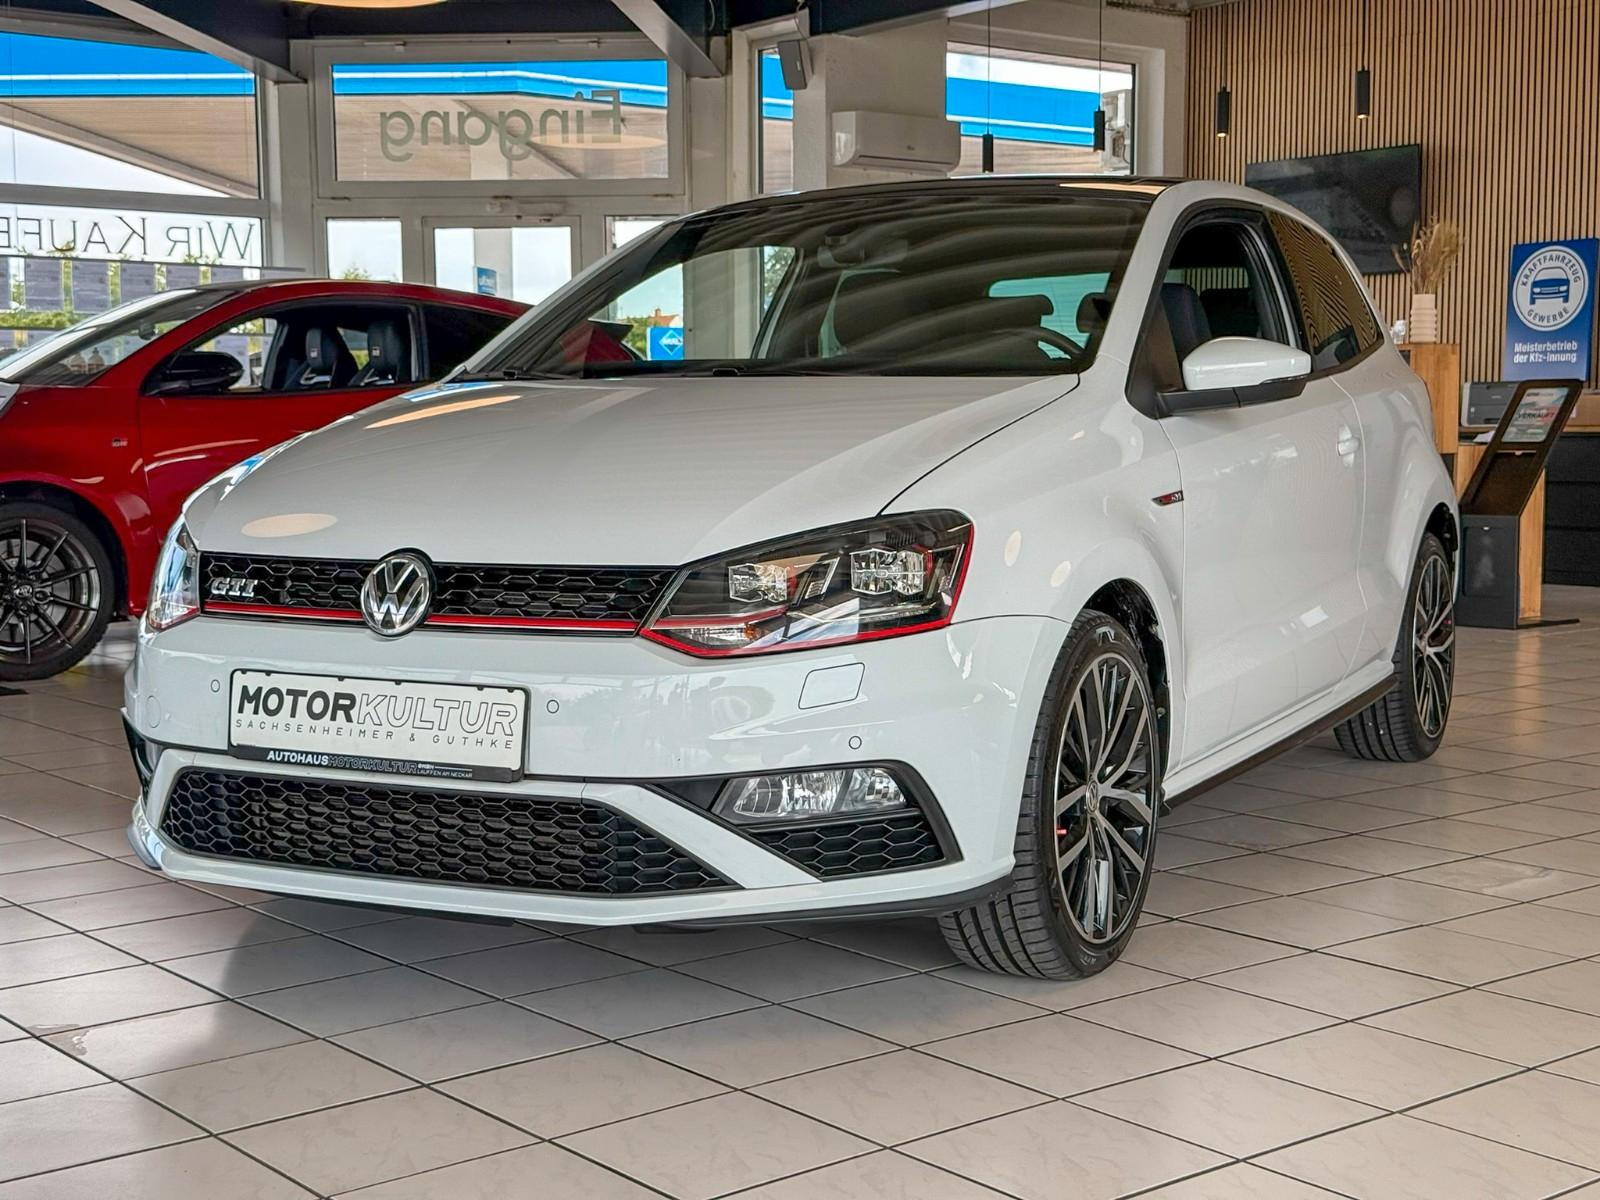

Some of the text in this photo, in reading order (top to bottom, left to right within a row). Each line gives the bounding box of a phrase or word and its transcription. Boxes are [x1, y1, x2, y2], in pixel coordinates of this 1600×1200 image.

[1521, 254, 1581, 287] KRAFTFAHRZEUG
[1527, 307, 1570, 324] GEWERBE
[1514, 340, 1578, 353] Meisterbetrieb
[1513, 354, 1528, 364] der
[210, 576, 258, 598] GTI
[237, 684, 518, 737] MOTORKULTUR
[235, 718, 513, 749] SACHSENHEIMER & GUTHKE
